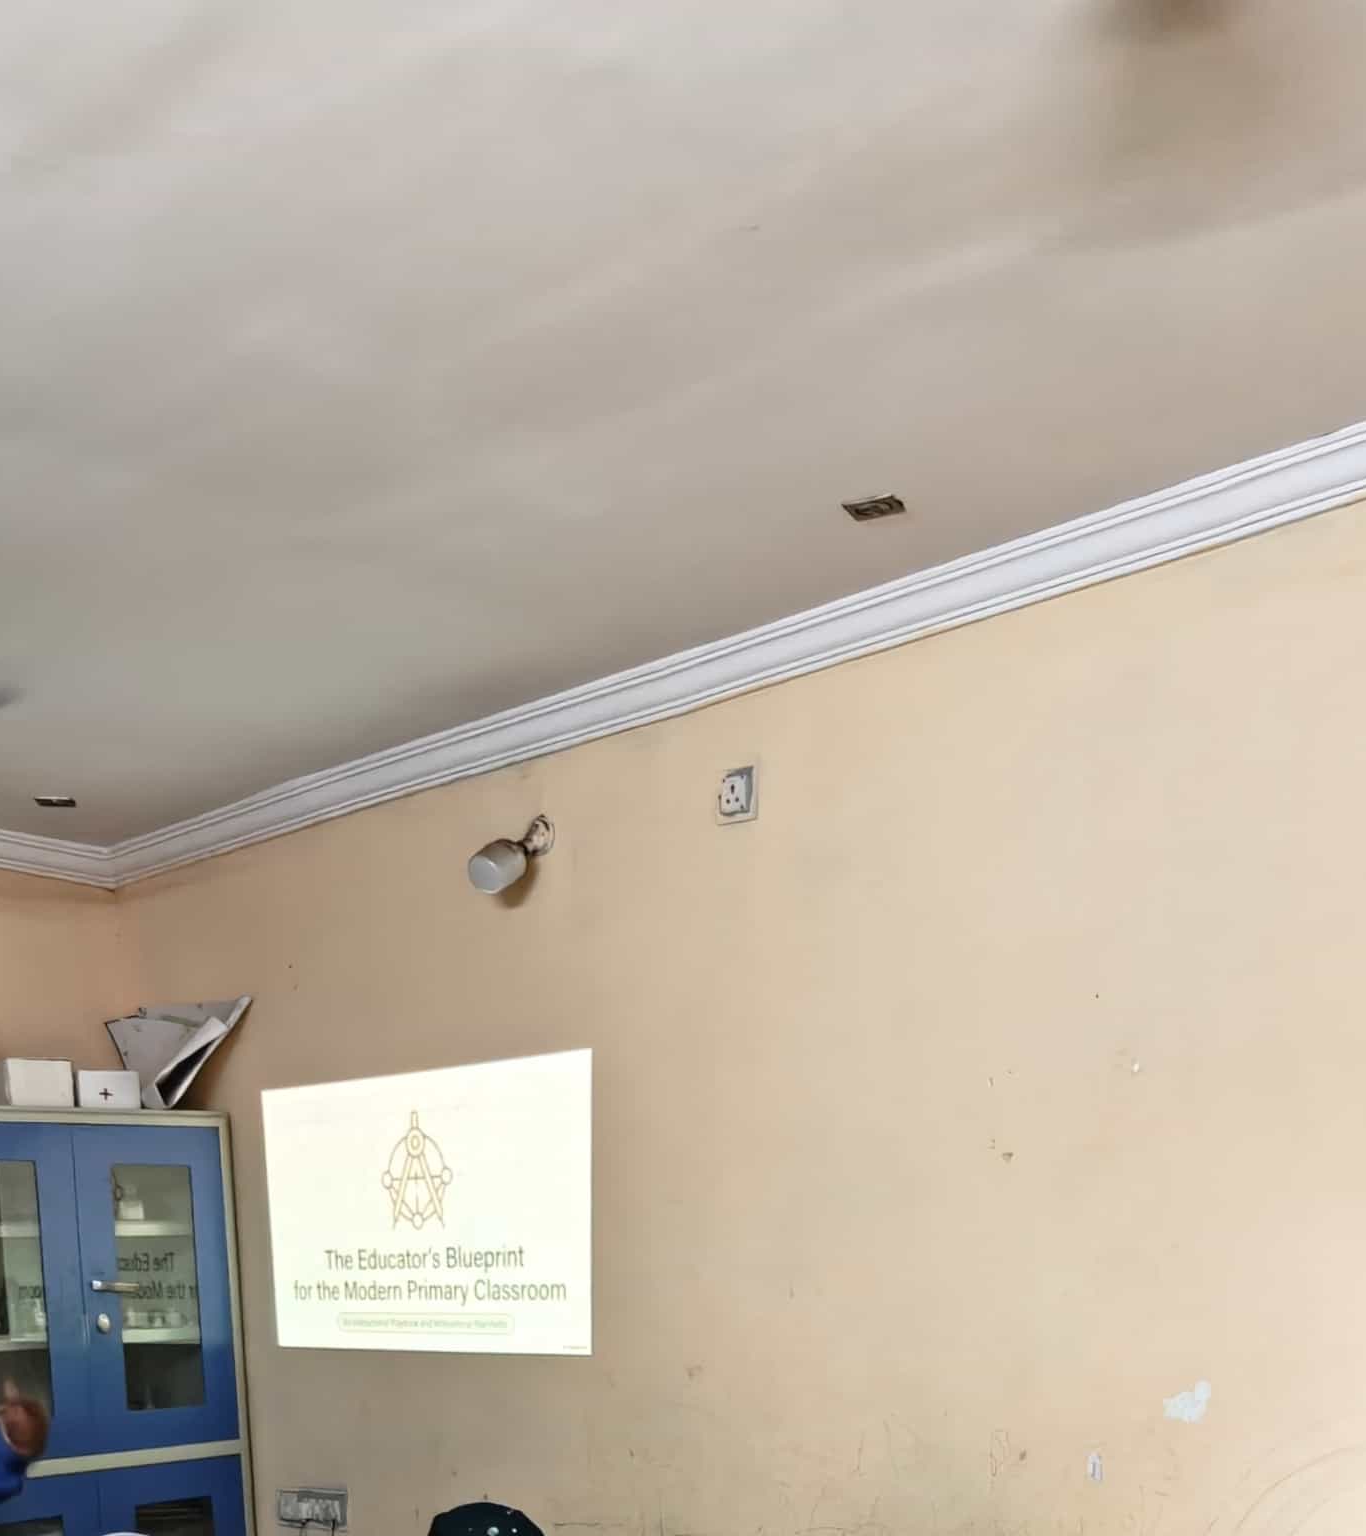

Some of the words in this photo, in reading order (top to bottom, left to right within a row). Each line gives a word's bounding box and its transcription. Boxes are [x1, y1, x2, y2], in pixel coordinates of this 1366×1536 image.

[324, 1250, 353, 1270] The
[358, 1247, 441, 1270] Educator's
[446, 1245, 525, 1273] Blueprint
[294, 1280, 313, 1301] for
[317, 1280, 340, 1301] the
[344, 1280, 402, 1301] Modern
[407, 1279, 468, 1306] Primary
[474, 1278, 567, 1301] Classroom
